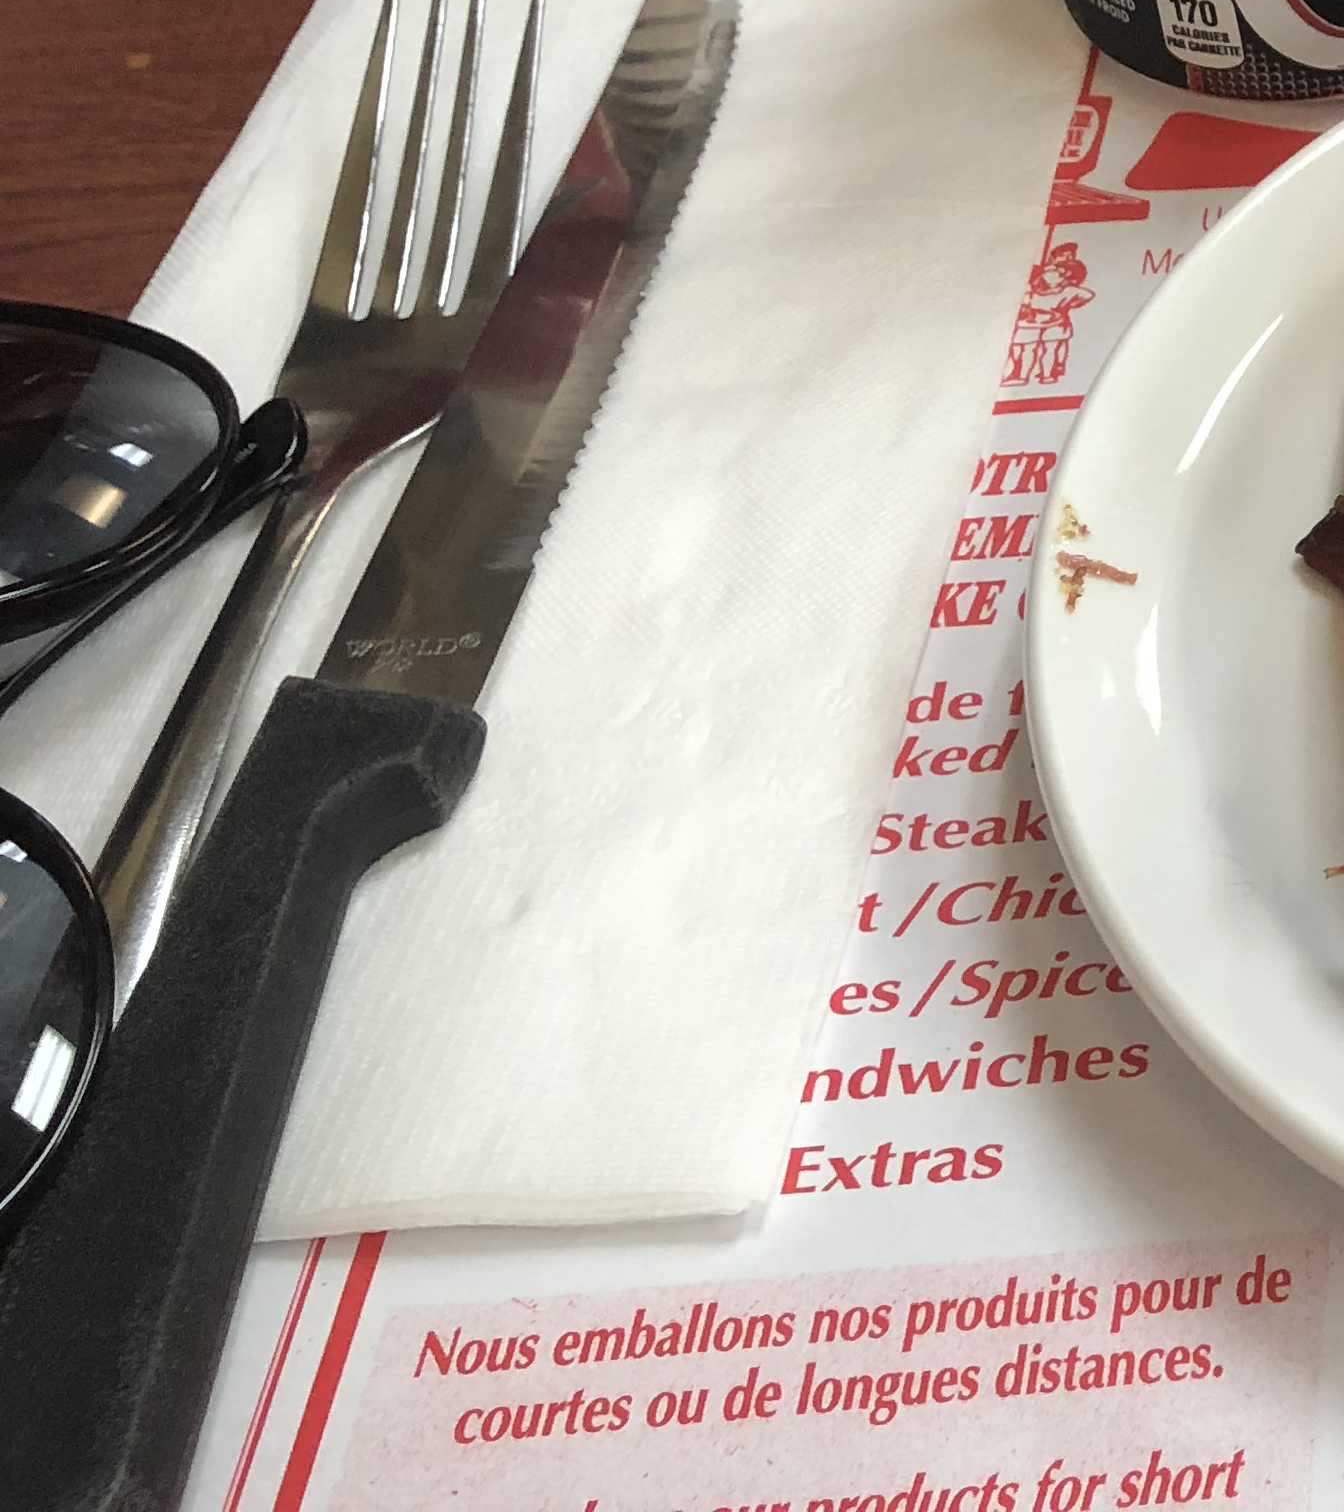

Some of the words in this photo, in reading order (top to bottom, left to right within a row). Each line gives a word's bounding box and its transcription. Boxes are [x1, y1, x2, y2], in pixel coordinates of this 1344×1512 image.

[906, 681, 983, 724] de
[781, 1144, 1003, 1195] Extras
[416, 1329, 540, 1378] Nous
[553, 1303, 795, 1367] emballons
[810, 1304, 893, 1345] nos
[902, 1274, 1099, 1357] produits
[1107, 1261, 1224, 1321] pour
[1236, 1256, 1292, 1307] de
[453, 1390, 632, 1446] courtes
[646, 1389, 709, 1428] ou
[723, 1368, 783, 1422] de
[797, 1362, 981, 1427] longues
[995, 1344, 1223, 1399] distances.
[1026, 1458, 1108, 1512] for
[1116, 1449, 1244, 1509] short
